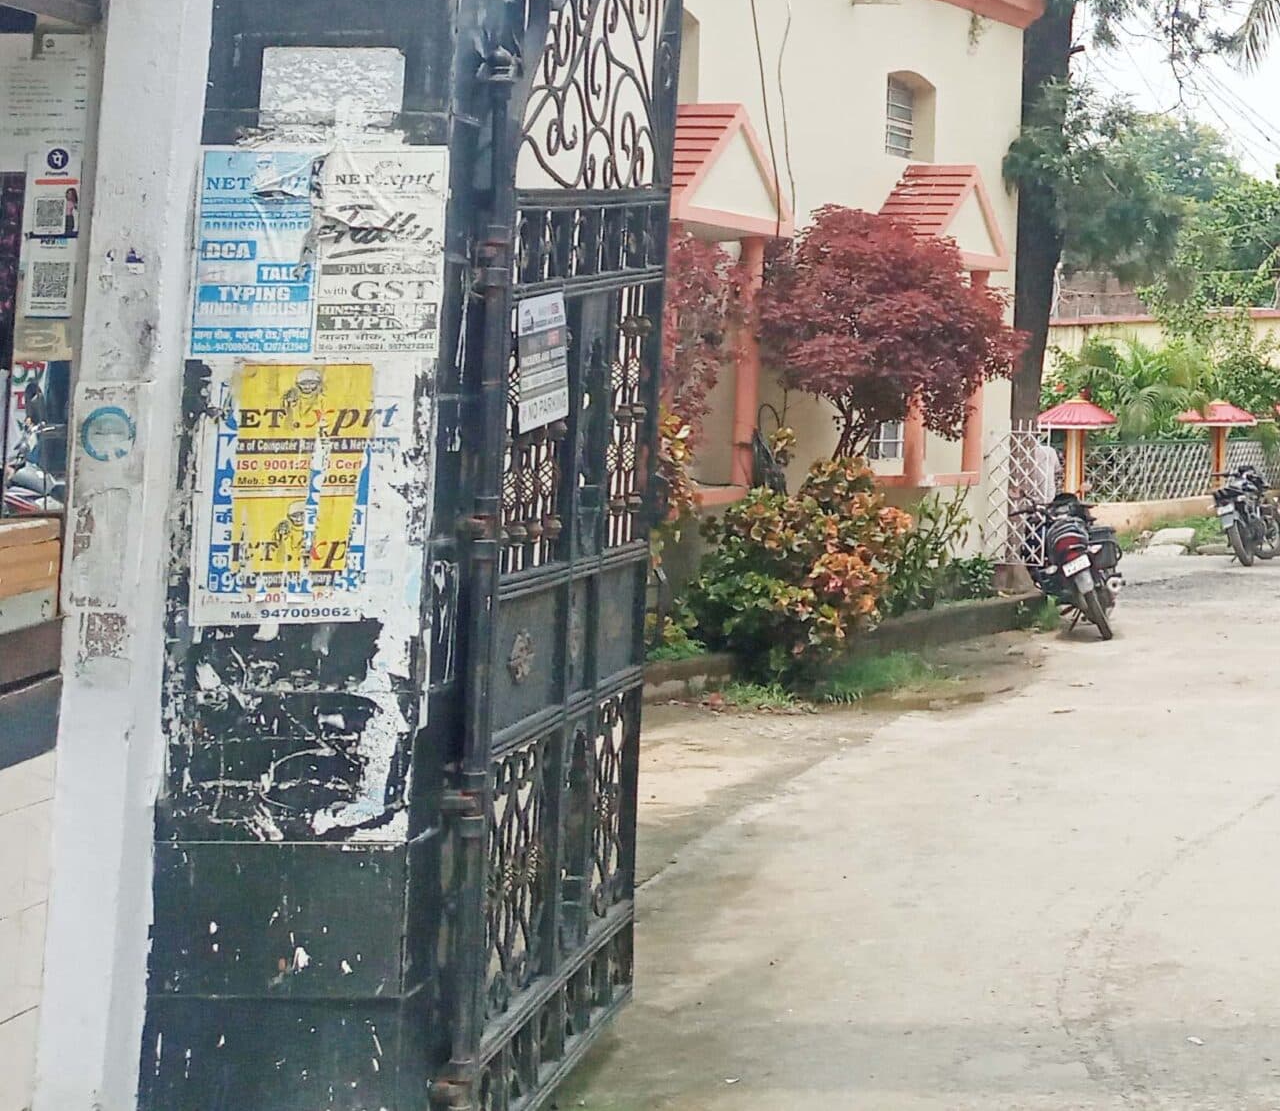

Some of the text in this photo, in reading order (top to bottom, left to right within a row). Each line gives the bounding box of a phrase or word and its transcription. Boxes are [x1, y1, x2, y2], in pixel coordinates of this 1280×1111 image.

[202, 242, 252, 258] DCA
[218, 286, 291, 301] TYPING
[351, 280, 434, 300] GST
[330, 315, 412, 329] TYPIN
[260, 607, 352, 619] 947009062
